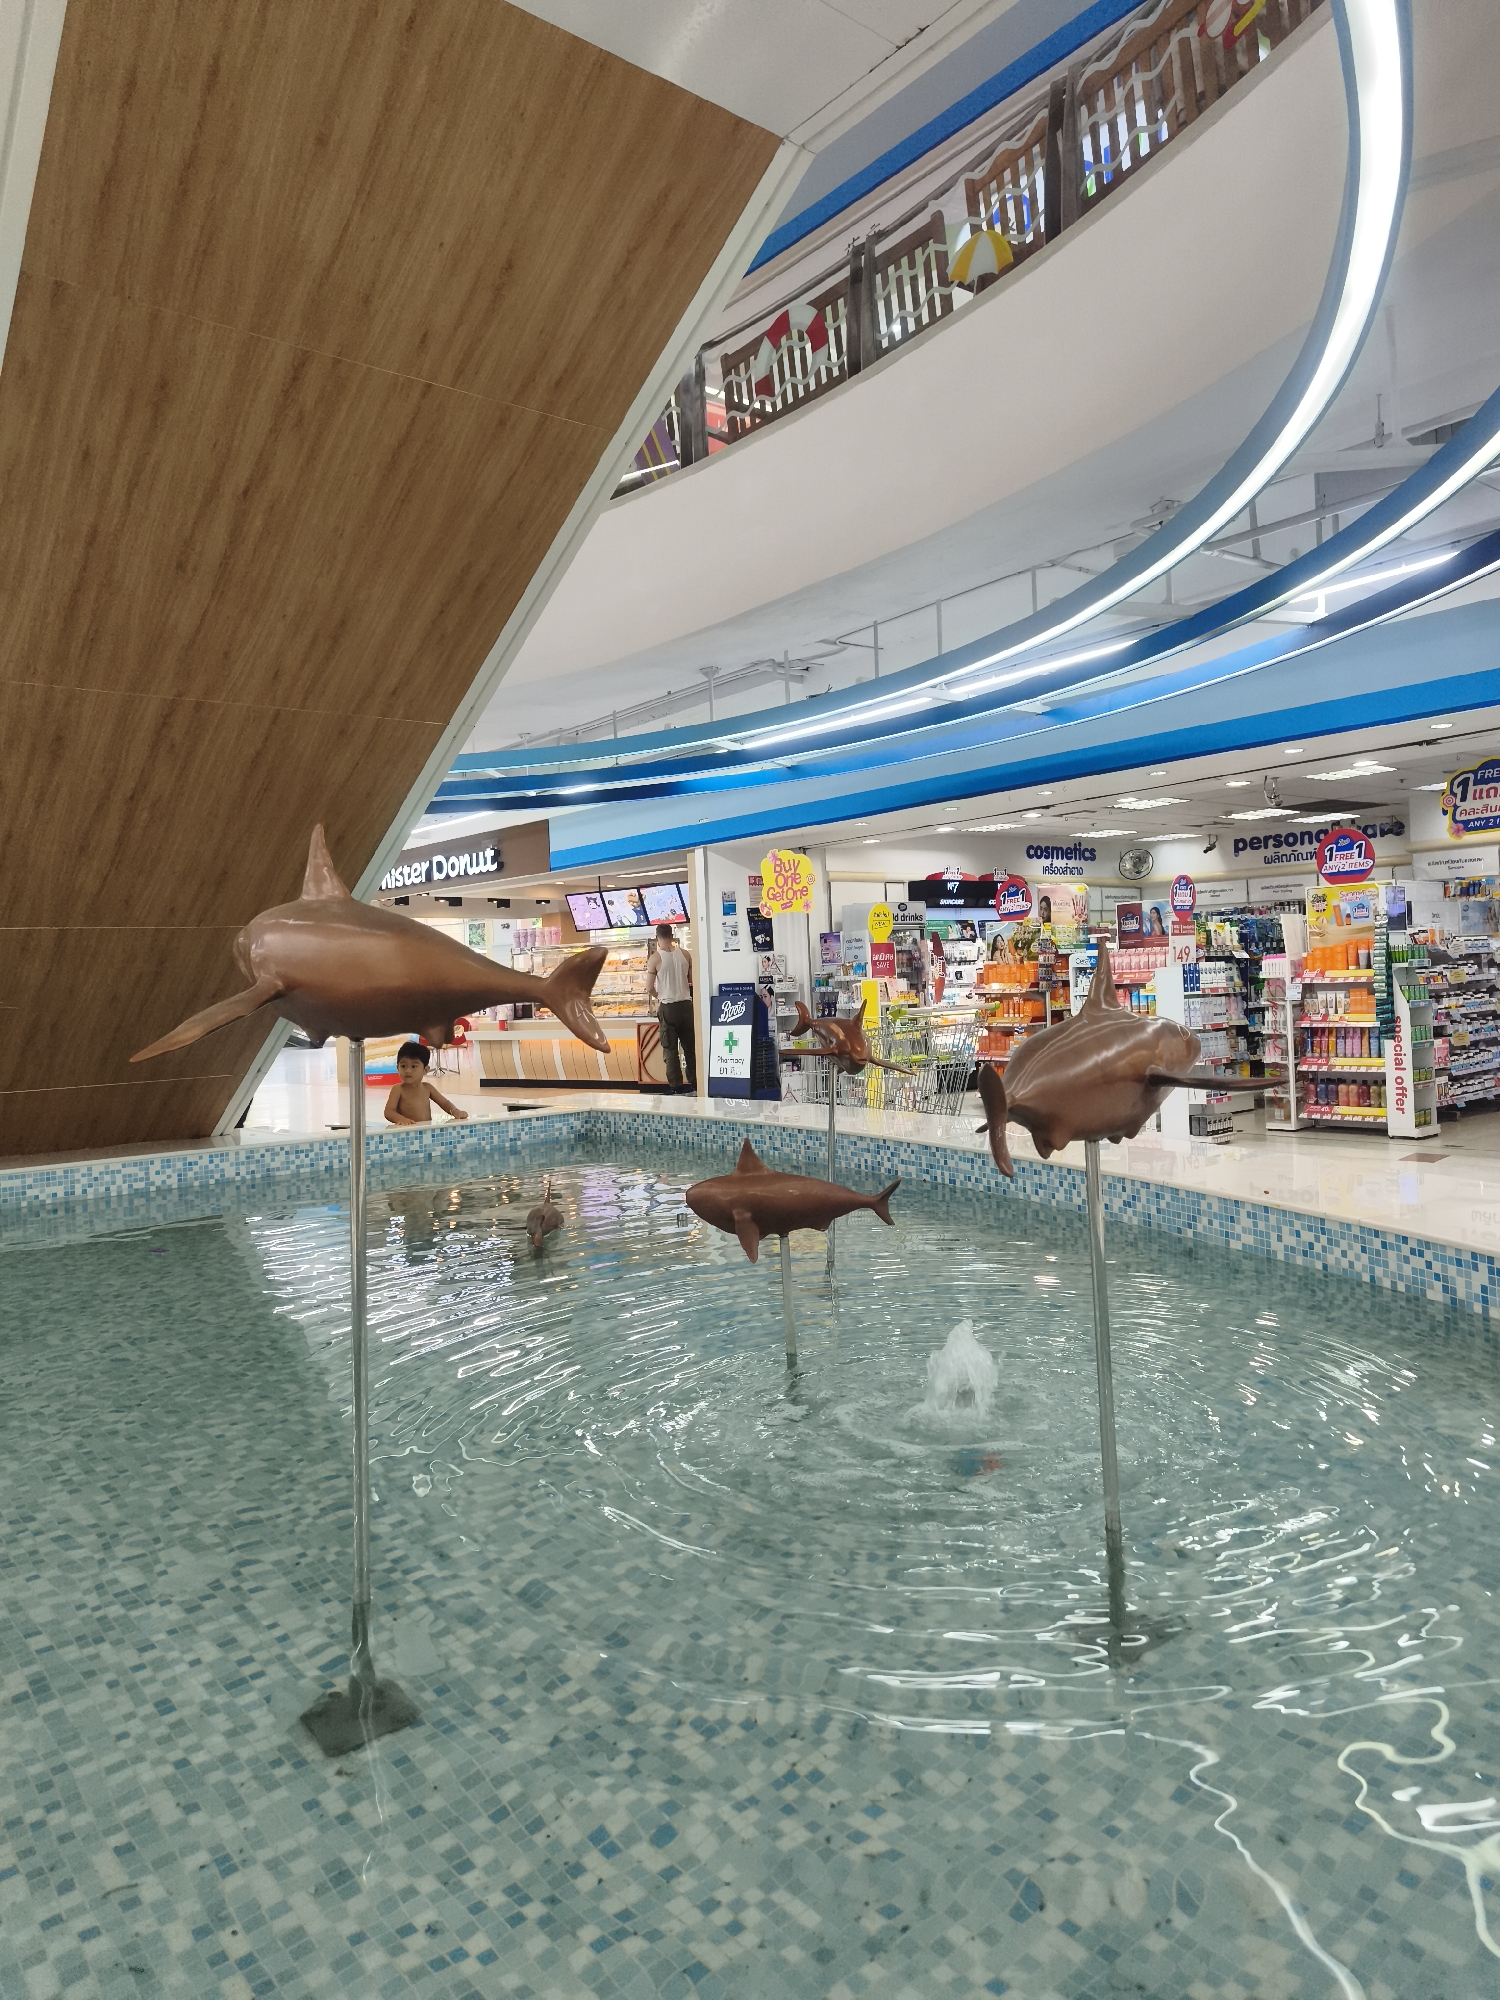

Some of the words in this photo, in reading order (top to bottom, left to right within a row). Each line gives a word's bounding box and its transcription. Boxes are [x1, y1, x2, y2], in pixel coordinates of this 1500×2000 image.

[1472, 786, 1500, 801] แถ
[1459, 804, 1500, 817] คละสิน
[1468, 820, 1486, 828] ANY
[1488, 818, 1494, 826] 2
[1234, 827, 1330, 857] persona
[1356, 820, 1406, 839] are
[1026, 842, 1097, 861] cosmetics
[1334, 851, 1355, 861] FREE
[432, 847, 498, 880] Donut
[773, 858, 801, 874] Buy
[1323, 864, 1338, 872] ANY
[1340, 862, 1346, 870] 2
[1348, 860, 1370, 869] ITEMS
[775, 872, 802, 889] One
[766, 886, 785, 902] Get
[785, 885, 809, 901] One
[1006, 896, 1020, 904] FREE
[900, 912, 923, 922] drinks
[1172, 945, 1191, 962] 149
[876, 961, 890, 969] SAVE
[718, 1000, 746, 1023] Boots
[717, 1055, 745, 1065] Pharmacy
[1394, 1075, 1408, 1115] offer
